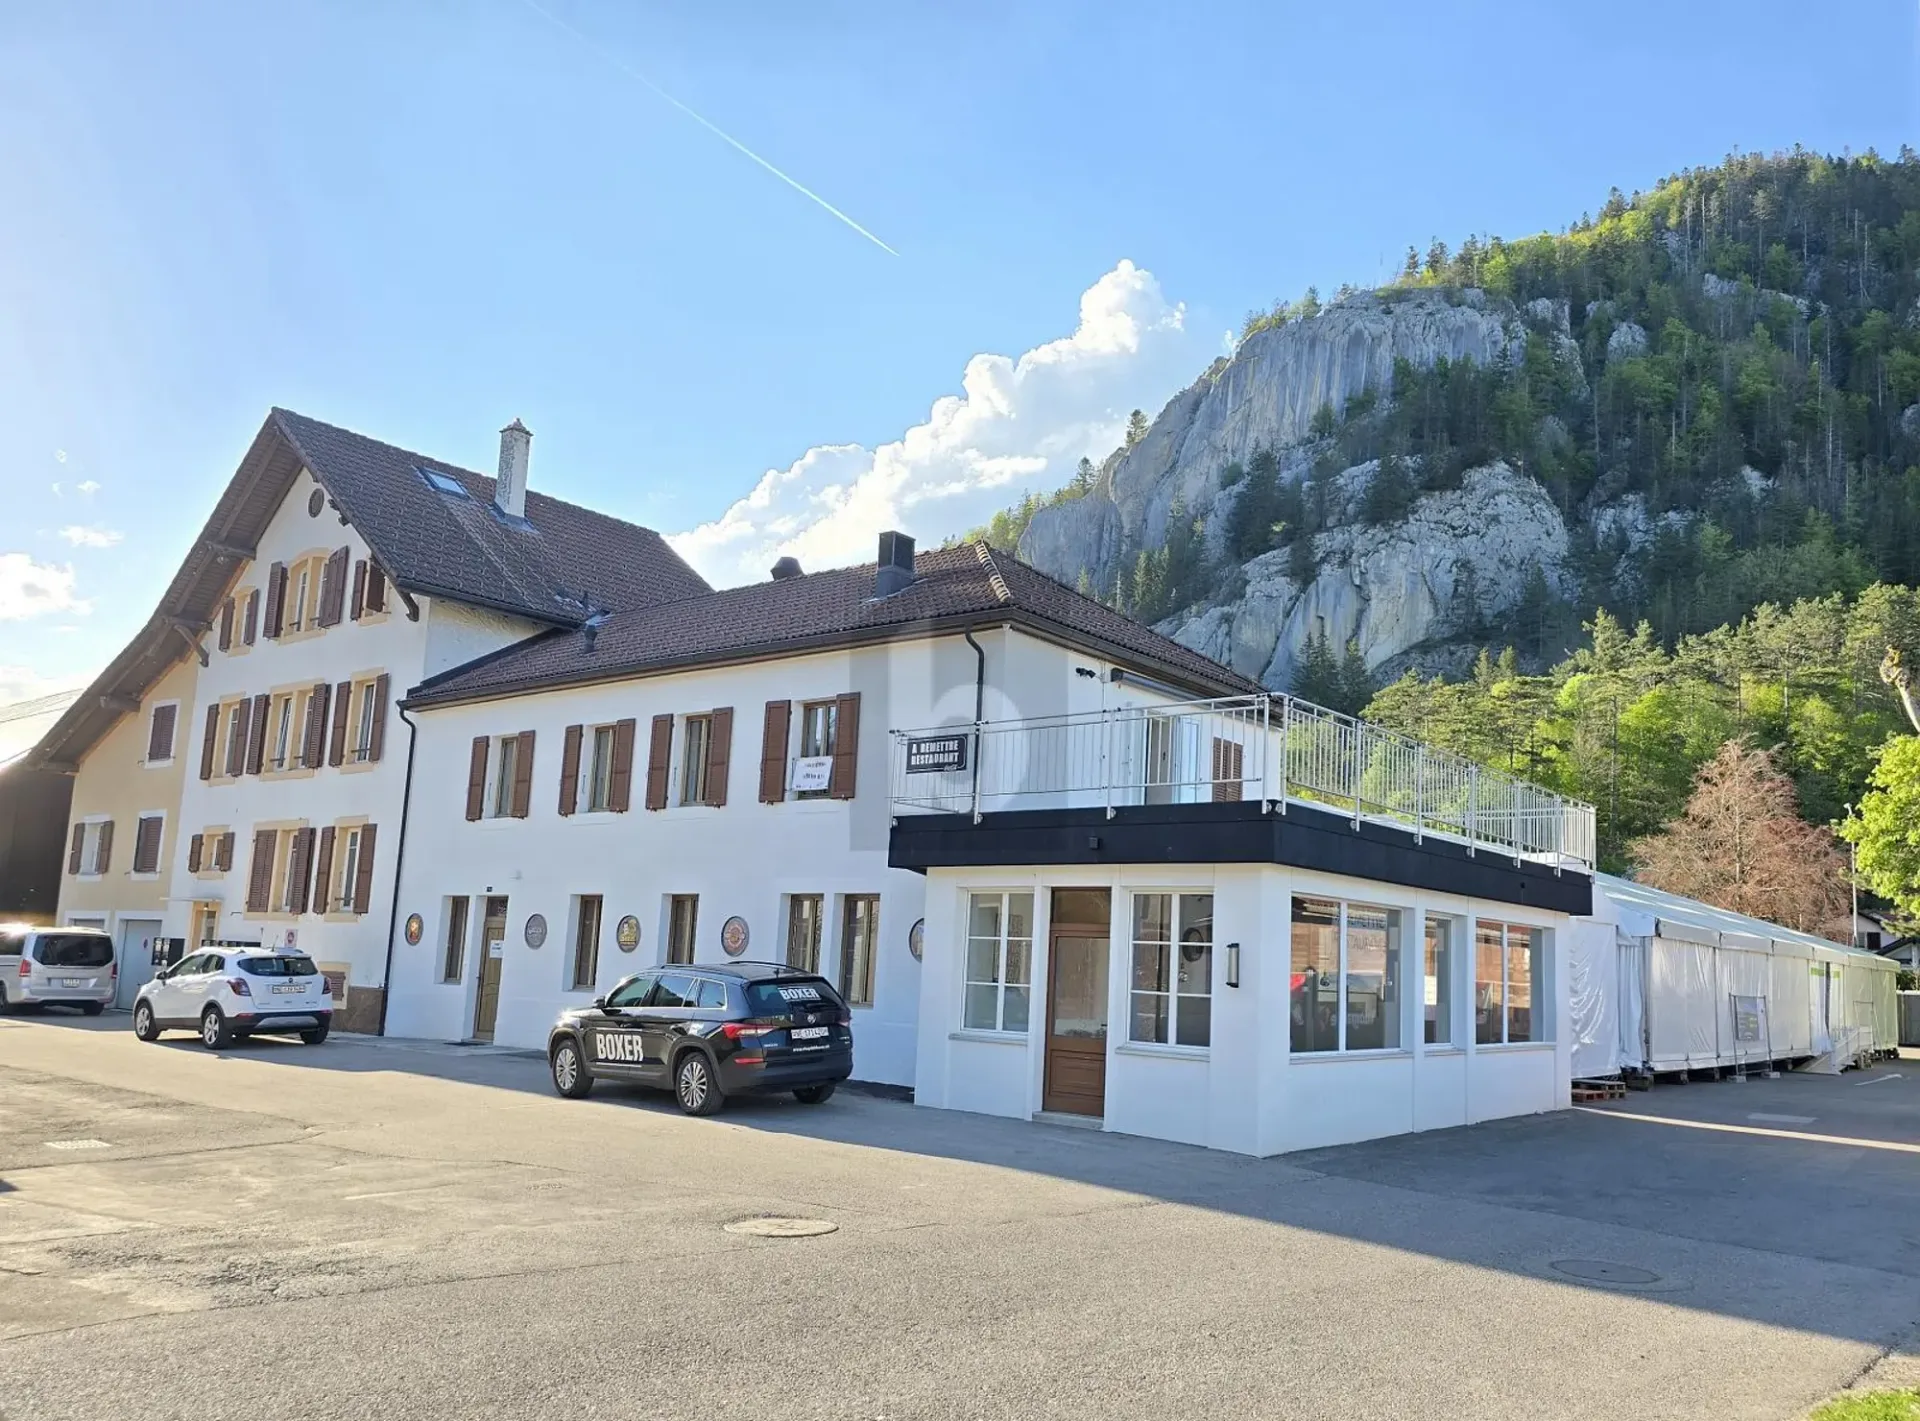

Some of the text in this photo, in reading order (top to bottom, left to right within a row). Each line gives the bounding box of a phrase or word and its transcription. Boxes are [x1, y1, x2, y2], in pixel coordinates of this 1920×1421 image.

[911, 740, 959, 754] A REMETTRE
[911, 752, 960, 765] RESTAURANT
[780, 988, 820, 1000] BOXER
[595, 1033, 644, 1062] BOXER
